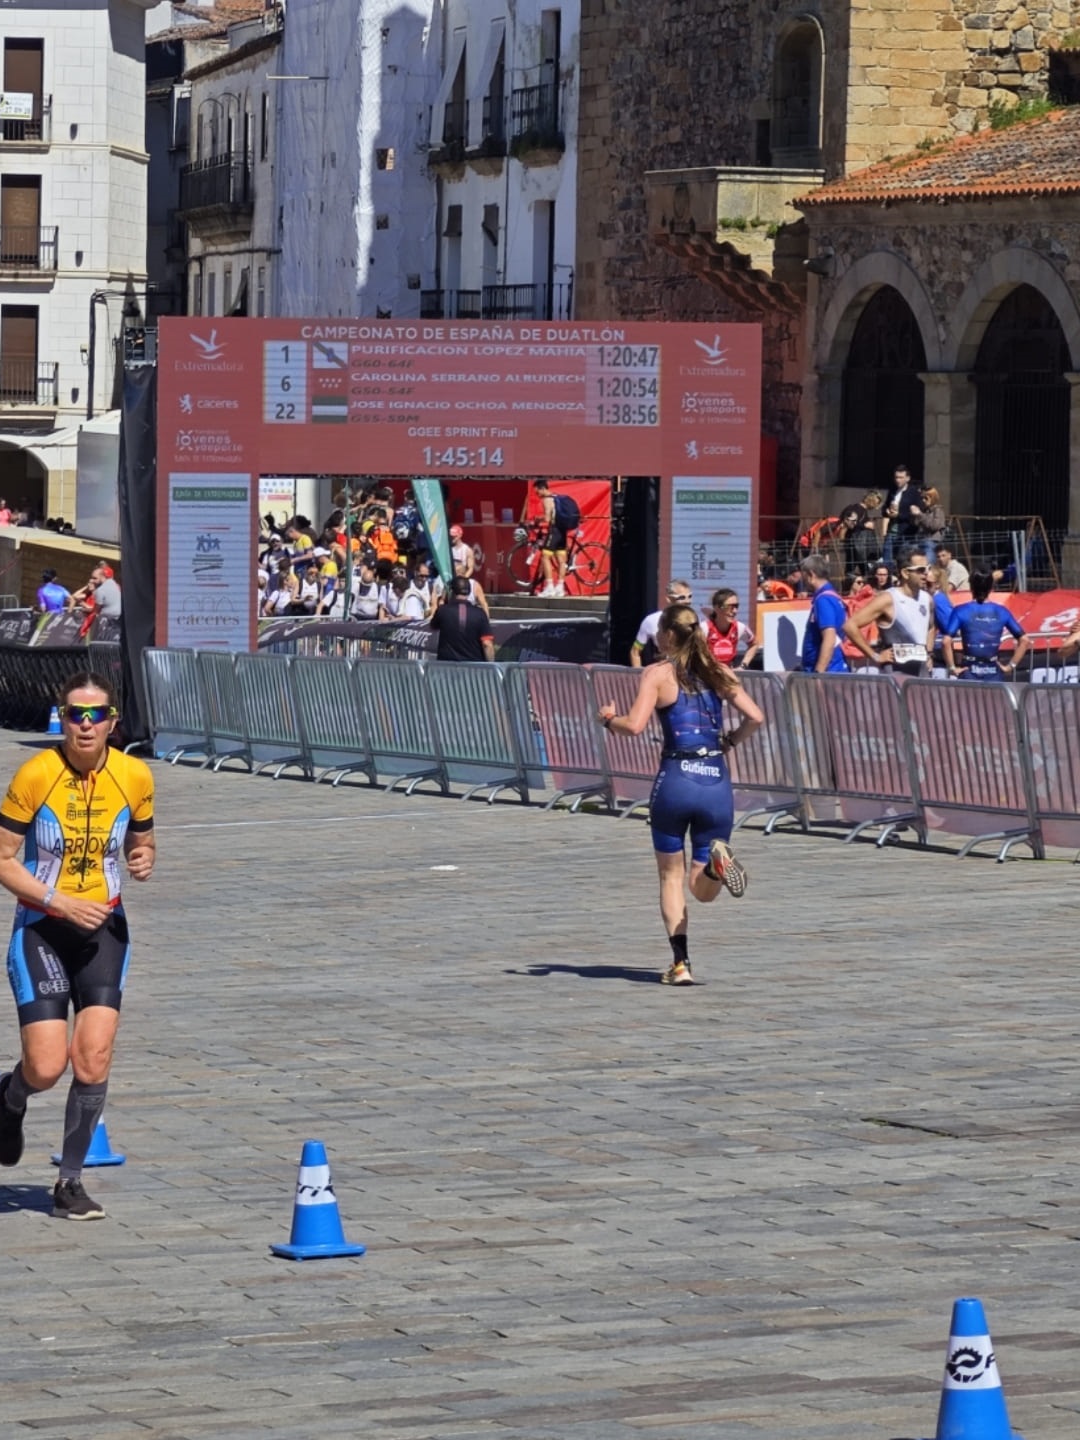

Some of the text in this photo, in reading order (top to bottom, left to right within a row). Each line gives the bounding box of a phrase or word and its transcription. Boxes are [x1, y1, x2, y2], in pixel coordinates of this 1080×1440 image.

[301, 325, 625, 342] CAMPEONATO DE ESPAÑA DE DUATLÓN
[280, 345, 290, 363] 1
[351, 344, 468, 355] PURIFICACION
[474, 346, 523, 356] LOPEZ
[597, 346, 659, 367] 1:20:47
[280, 375, 292, 392] 6
[351, 373, 426, 383] CAROLINA
[431, 374, 501, 383] SERRANO
[597, 377, 658, 398] 1:20:54
[274, 400, 658, 425] 22 JOSE IGNACIO OCHOA MENDOZA 1:38:56
[407, 427, 518, 438] GGEE SPRINT Final
[423, 446, 504, 467] 1:45:14
